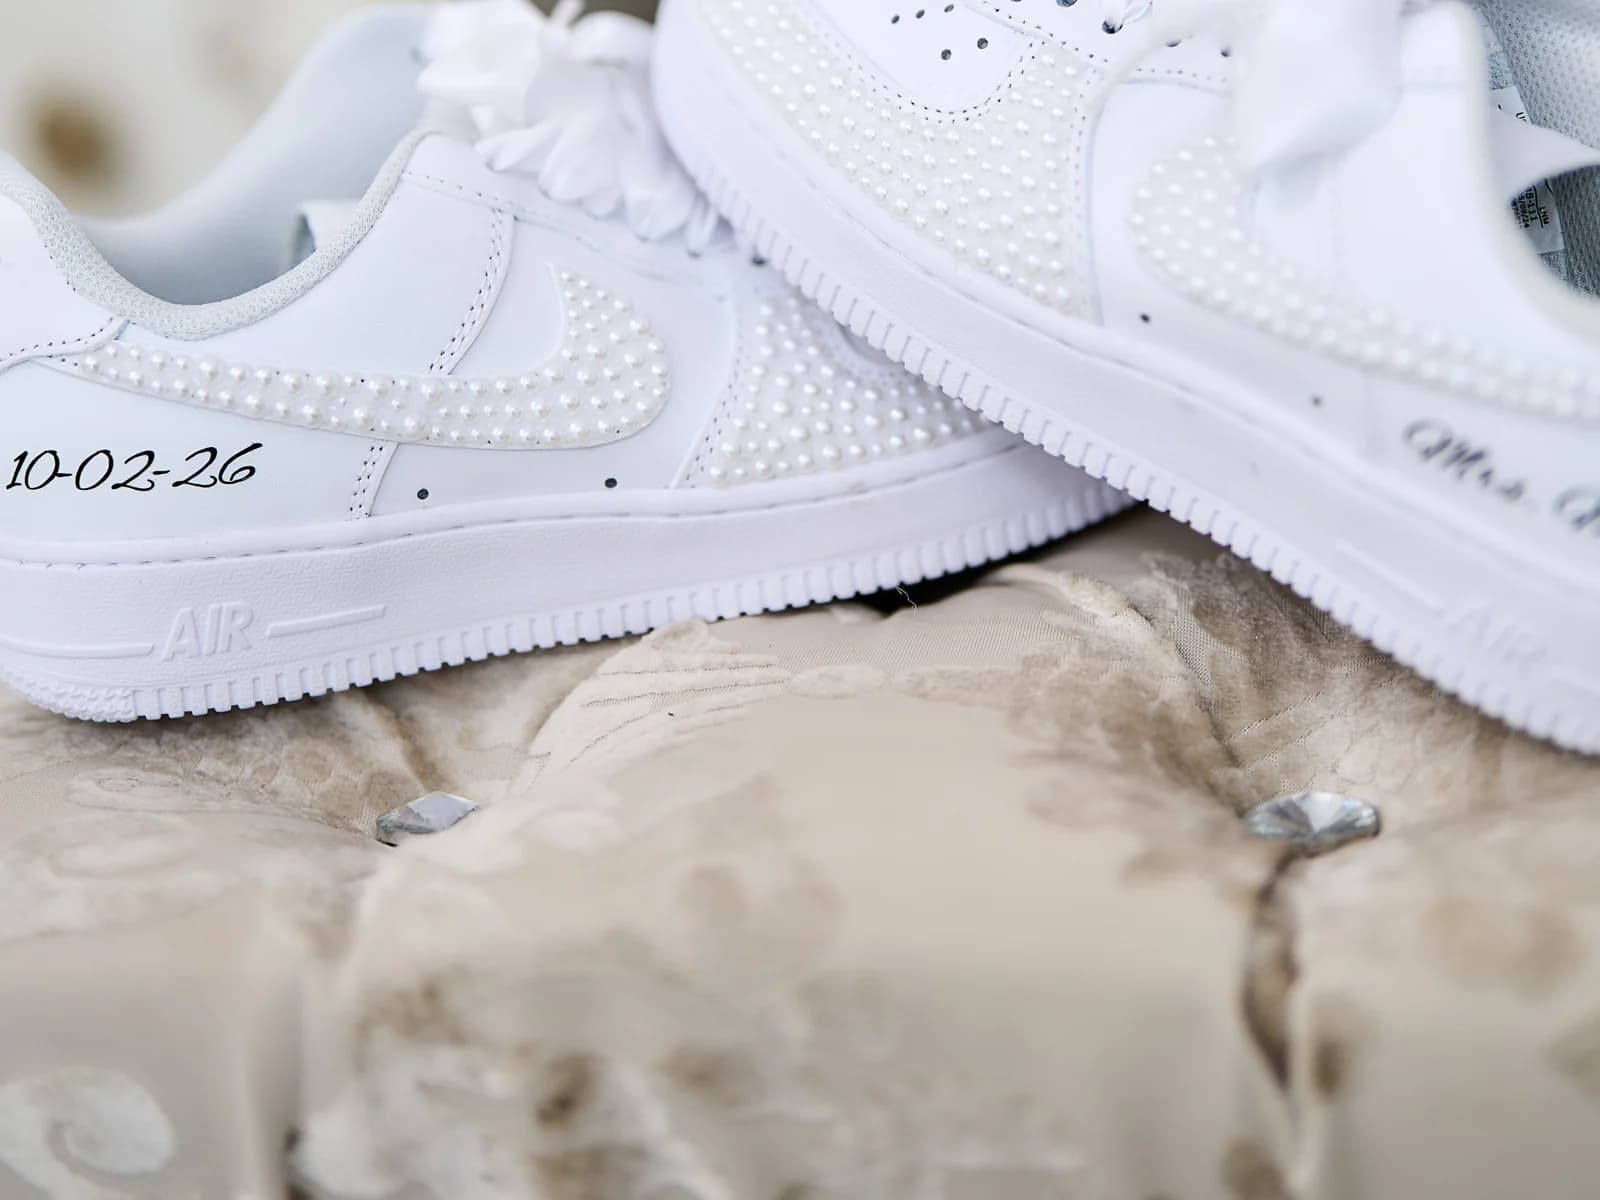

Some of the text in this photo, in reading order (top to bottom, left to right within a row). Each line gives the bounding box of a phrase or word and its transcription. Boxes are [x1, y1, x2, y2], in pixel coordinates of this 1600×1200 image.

[1517, 192, 1530, 228] 5/09/24
[6, 442, 263, 491] 10-02-26
[160, 600, 255, 662] AIR
